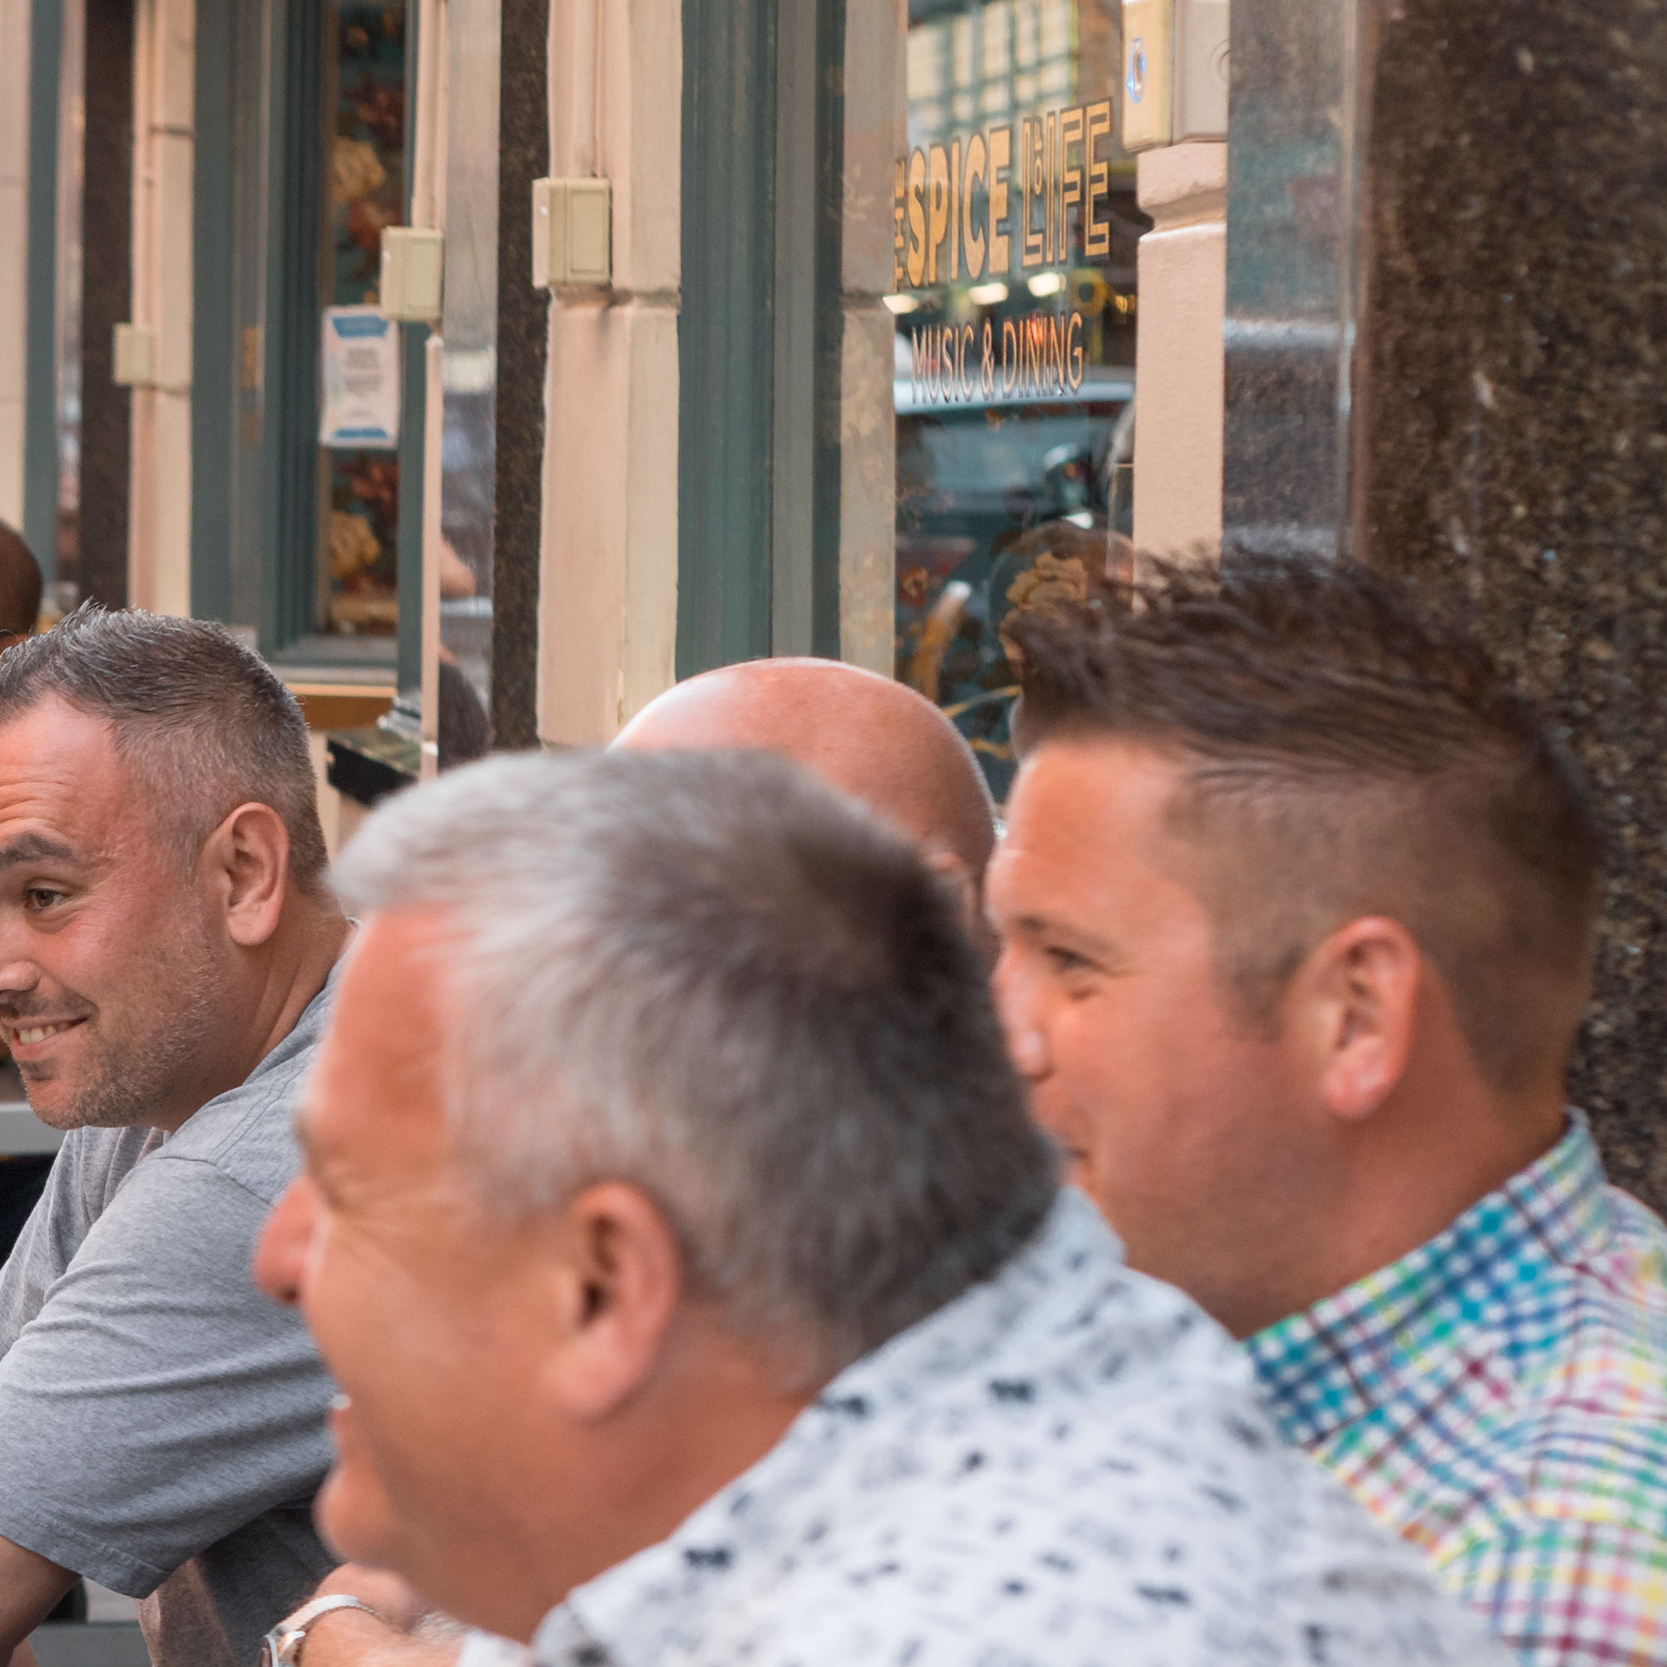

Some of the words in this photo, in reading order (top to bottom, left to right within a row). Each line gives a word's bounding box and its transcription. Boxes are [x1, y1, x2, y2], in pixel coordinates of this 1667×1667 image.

[907, 126, 1011, 288] SPICE
[1022, 99, 1111, 268] LIFE
[912, 322, 975, 404] MUSIC
[980, 315, 996, 402] &
[1002, 311, 1084, 399] DINING
